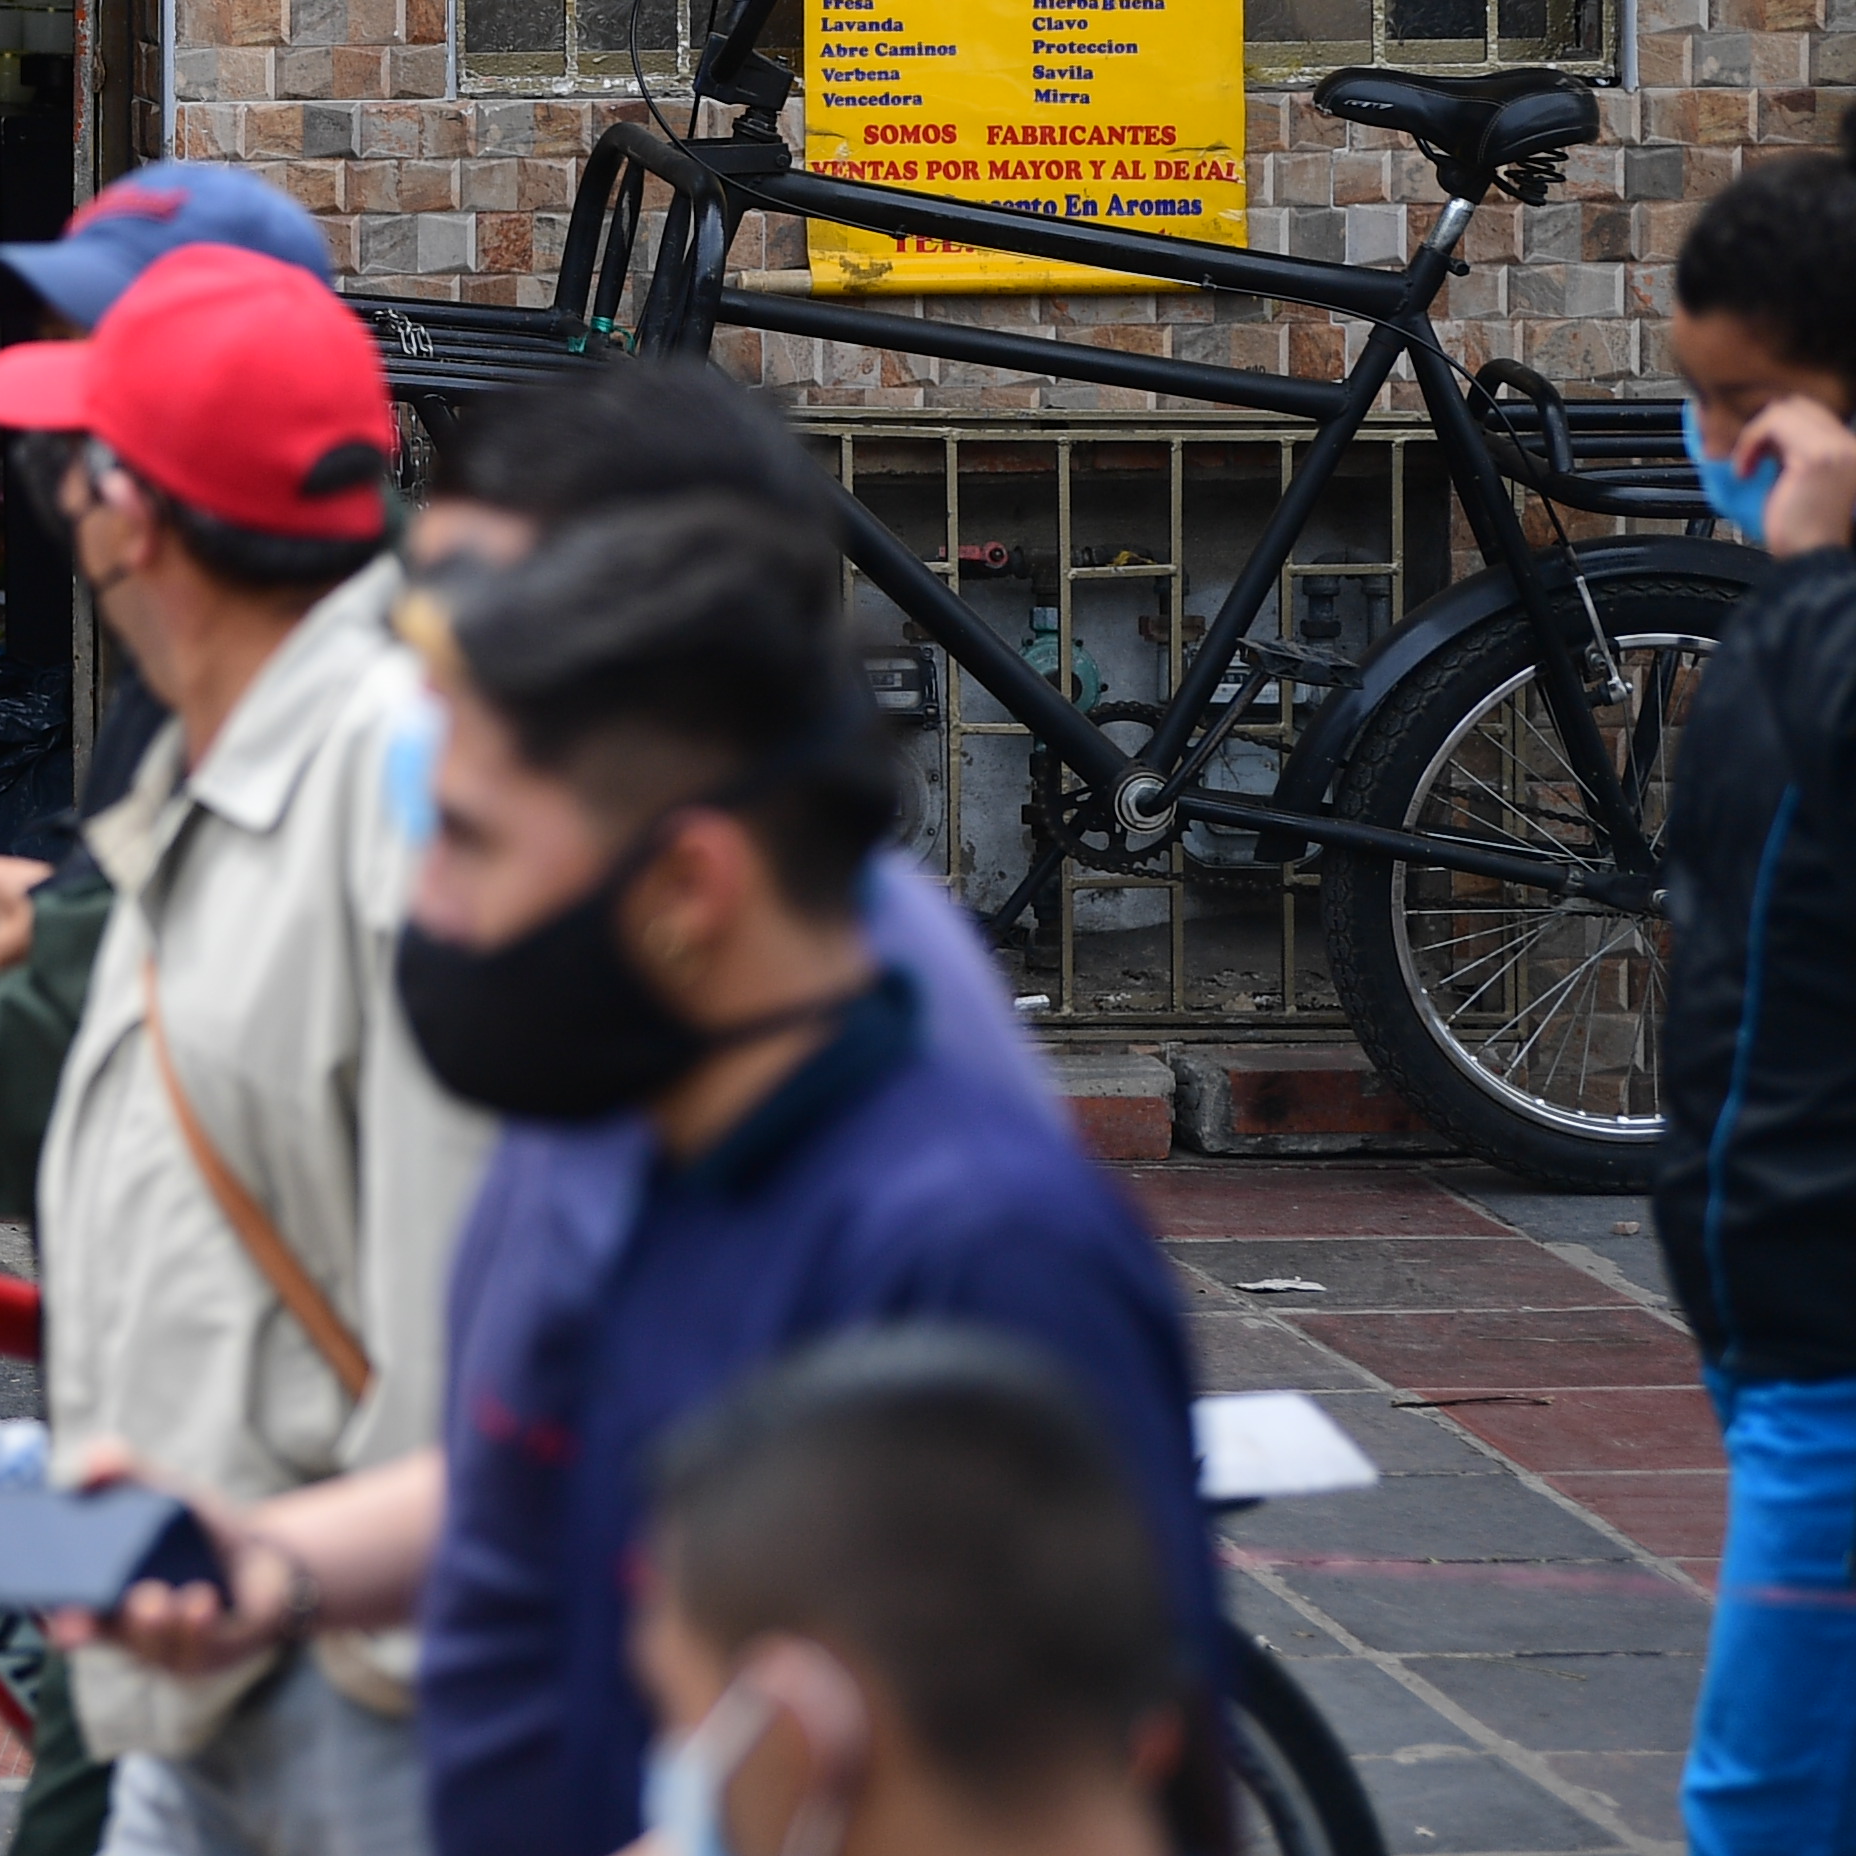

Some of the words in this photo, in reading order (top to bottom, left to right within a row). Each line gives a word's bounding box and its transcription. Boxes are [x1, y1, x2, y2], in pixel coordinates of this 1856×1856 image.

[863, 123, 957, 145] SOMOS
[986, 125, 1177, 146] FABRICANTES
[811, 160, 918, 180] VENTAS
[926, 160, 980, 180] POR
[987, 160, 1083, 180] MAYOR
[1089, 160, 1104, 180] Y
[1111, 160, 1146, 180] AL
[1065, 194, 1097, 216] En
[1106, 194, 1202, 216] Aromas
